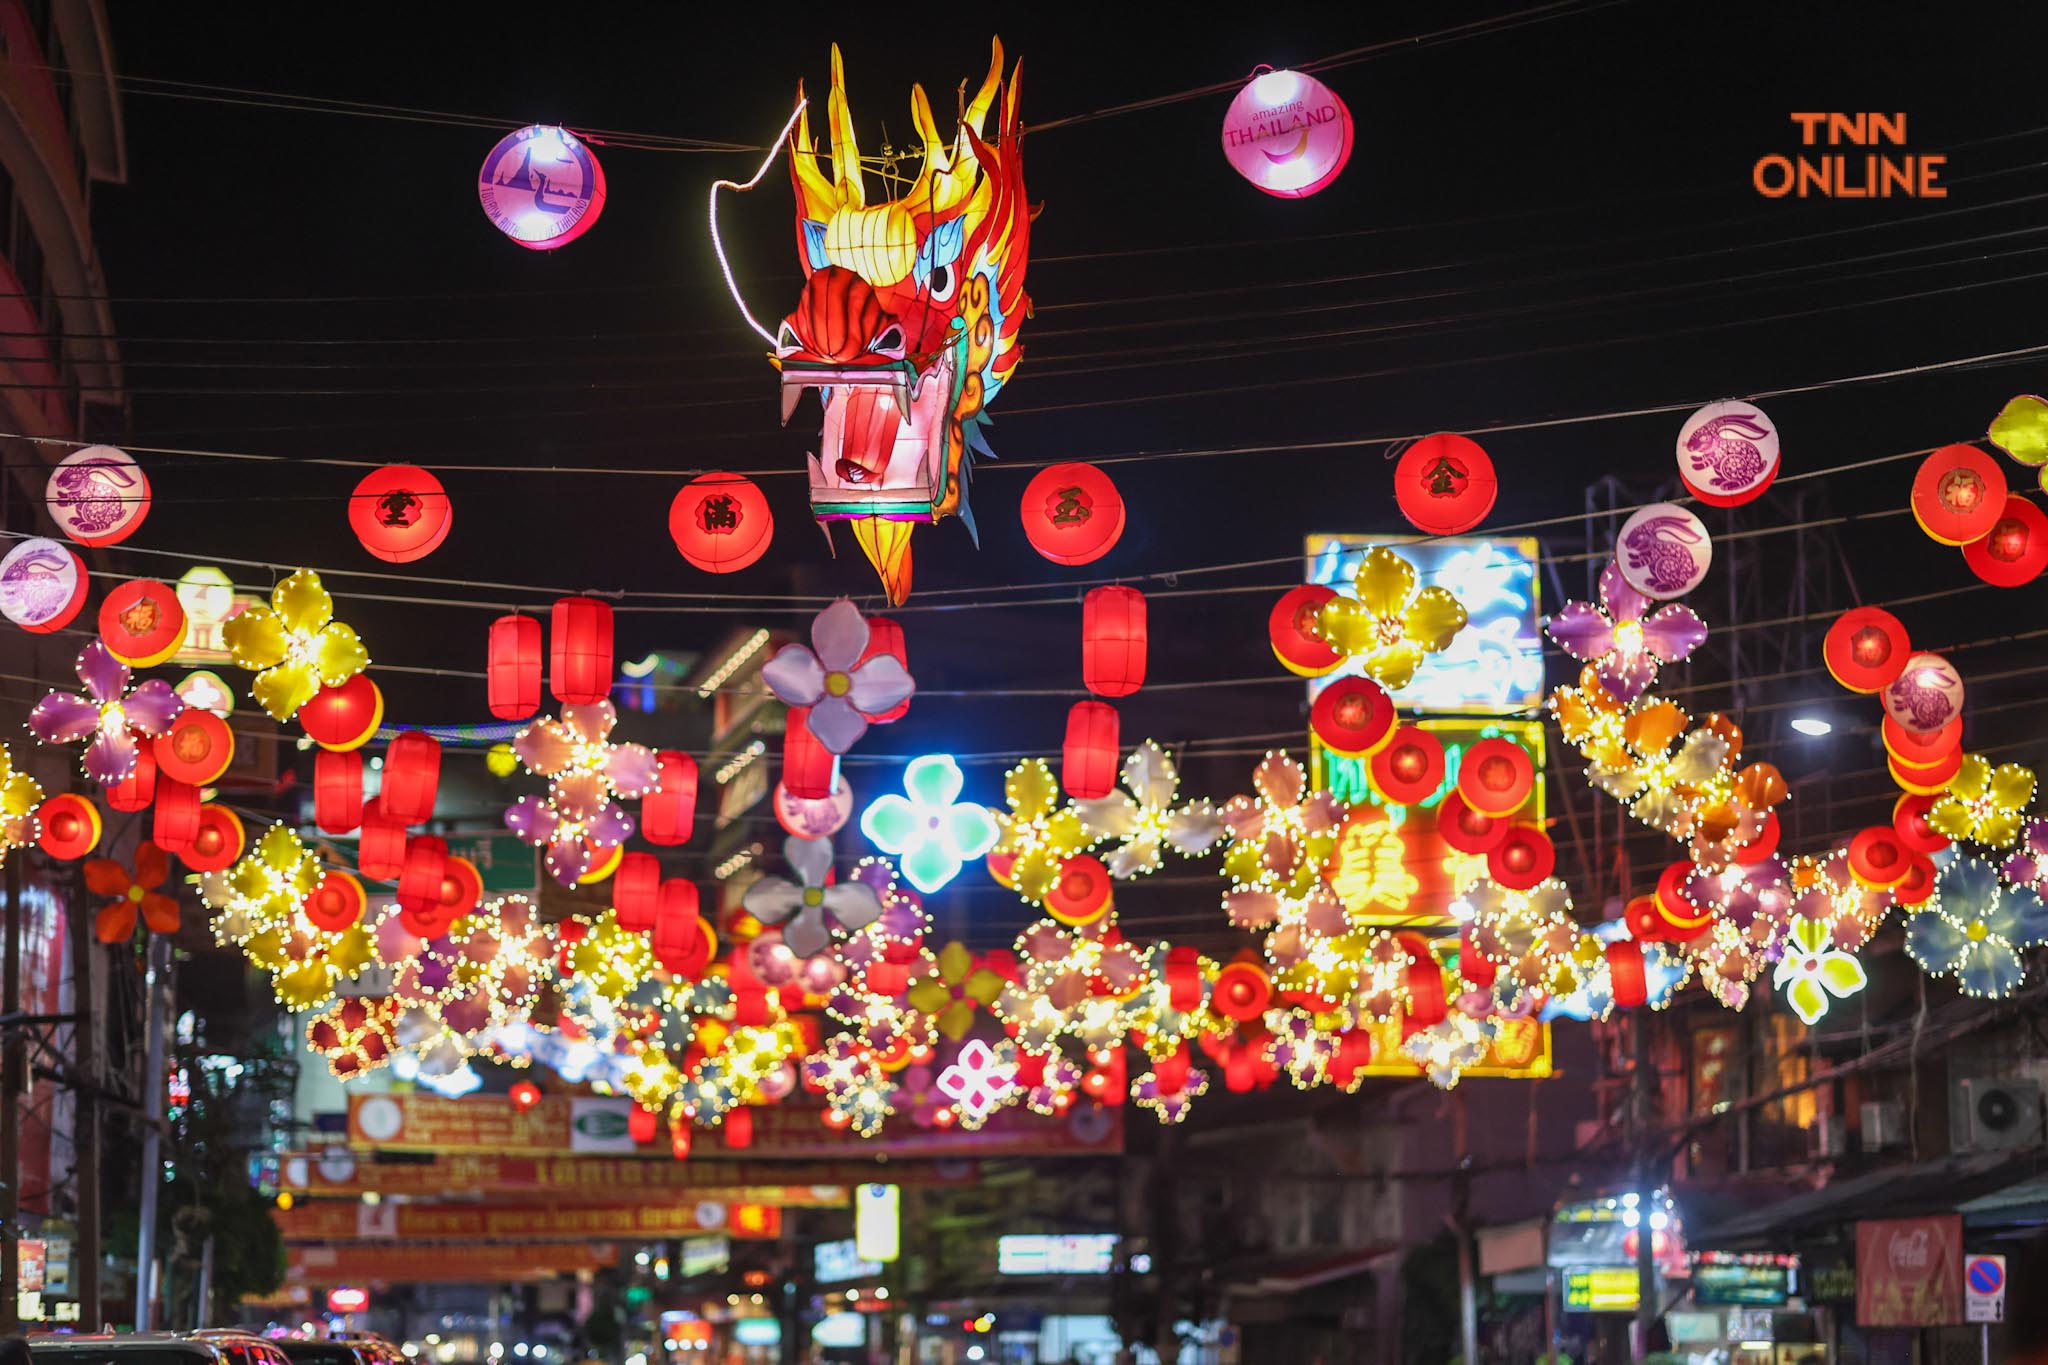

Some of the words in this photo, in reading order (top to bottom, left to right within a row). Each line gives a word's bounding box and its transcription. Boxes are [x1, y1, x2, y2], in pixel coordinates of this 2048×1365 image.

[1225, 105, 1336, 147] THAILAND
[1252, 101, 1304, 121] amazing
[556, 199, 588, 233] THAILAND
